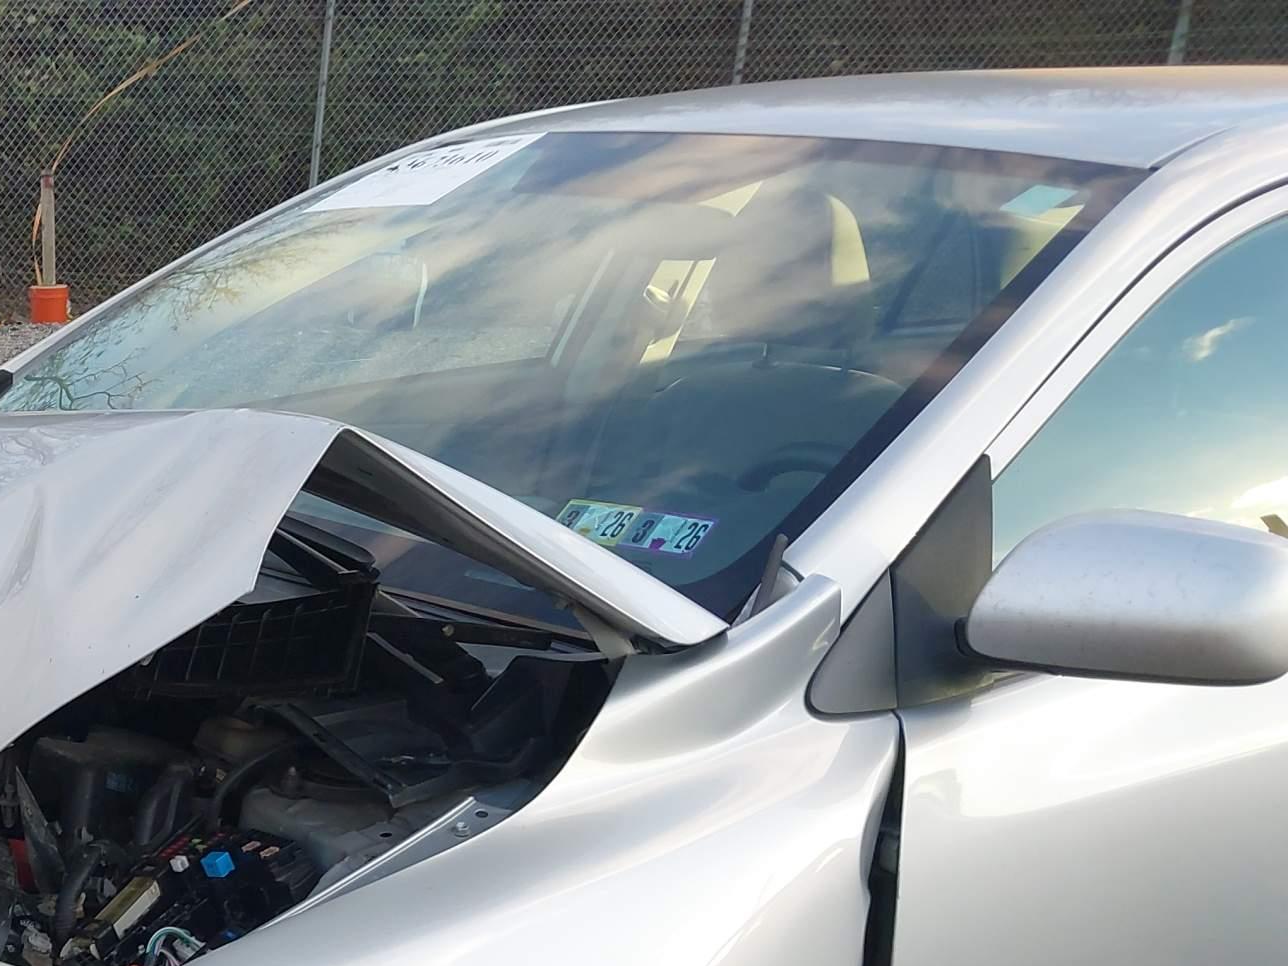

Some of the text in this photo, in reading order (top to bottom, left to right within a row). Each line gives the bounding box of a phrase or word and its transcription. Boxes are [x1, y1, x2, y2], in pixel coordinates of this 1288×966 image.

[600, 511, 634, 537] 26
[632, 519, 709, 550] 3 26
